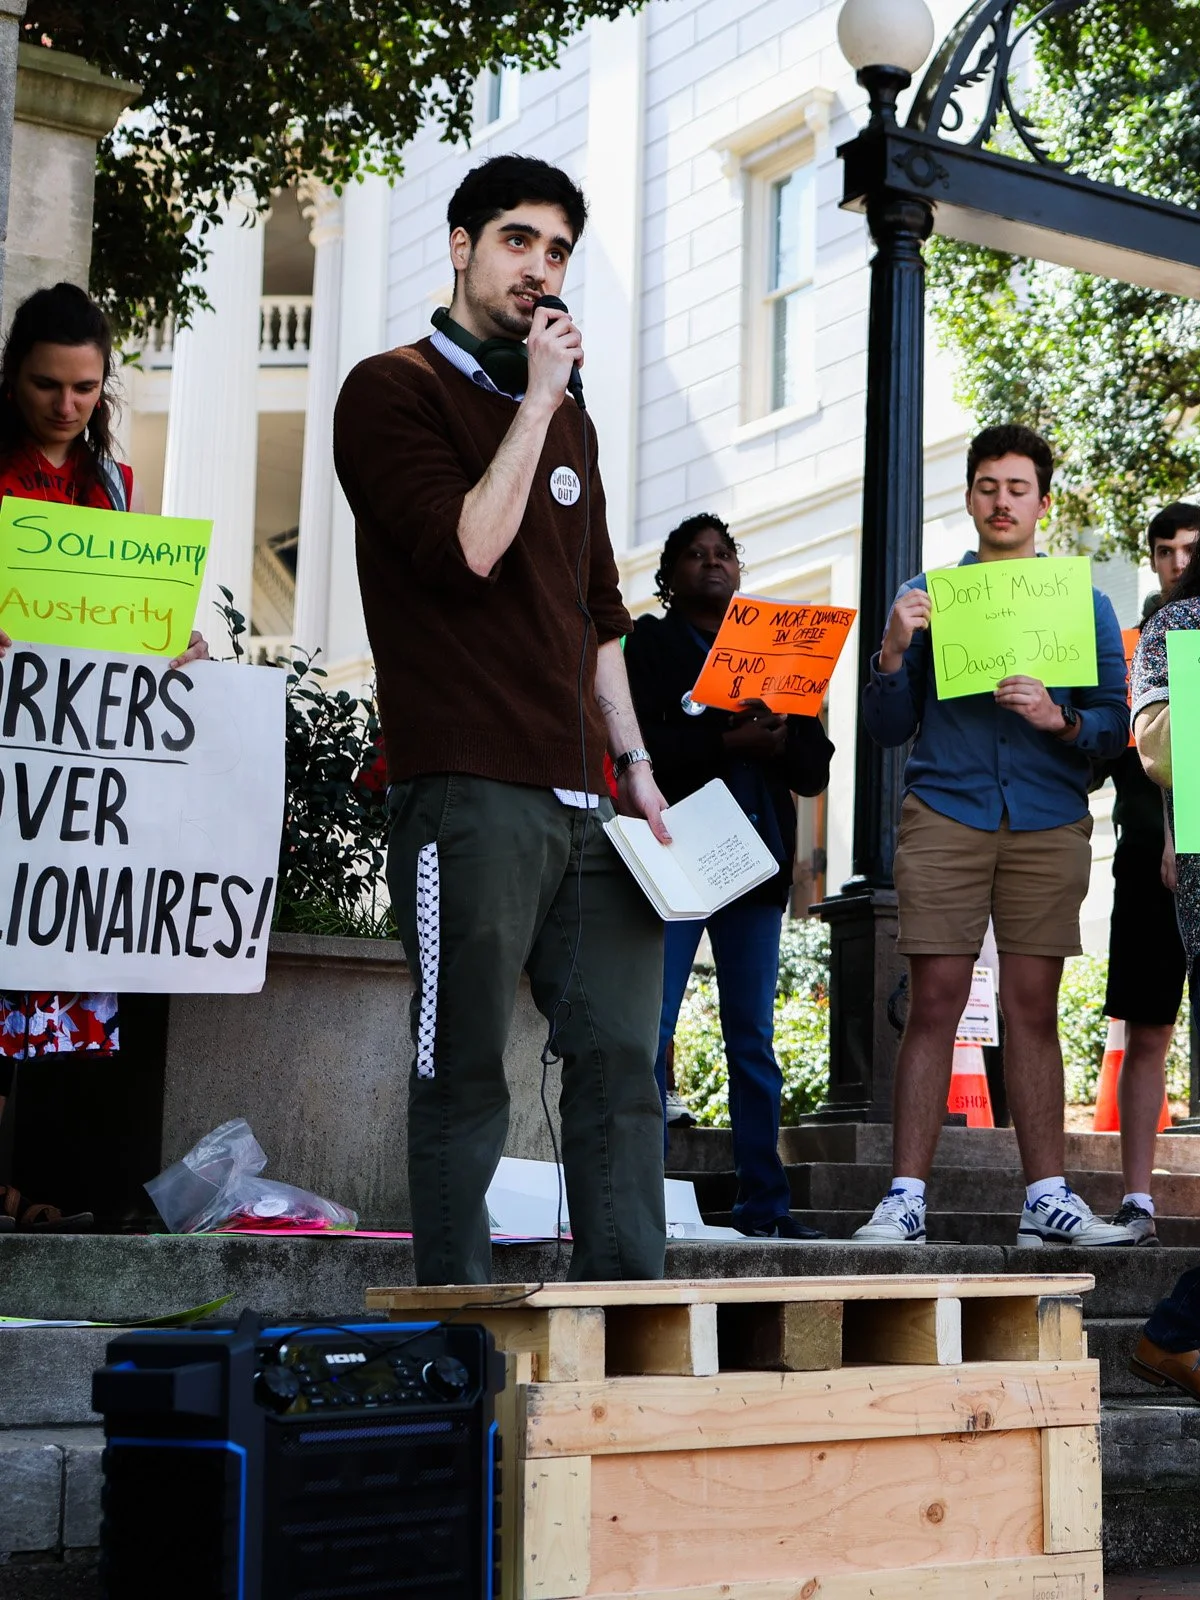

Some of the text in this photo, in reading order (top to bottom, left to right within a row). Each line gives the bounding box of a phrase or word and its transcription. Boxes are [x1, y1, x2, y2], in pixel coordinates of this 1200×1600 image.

[557, 488, 574, 501] OUT
[12, 515, 206, 576] SOLIDARITY
[930, 567, 1074, 613] Don't "Musk"
[0, 587, 173, 651] Austerity
[728, 604, 760, 626] NO
[769, 608, 811, 628] MORE
[985, 608, 1017, 621] with
[772, 627, 828, 643] IN OFFICE
[1022, 629, 1081, 663] Jobs
[712, 652, 766, 674] FUND
[0, 650, 196, 752] RKERS
[0, 762, 129, 846] VER
[0, 861, 274, 960] IONAIRES!
[954, 1095, 988, 1109] SHOP
[325, 1352, 367, 1364] ION
